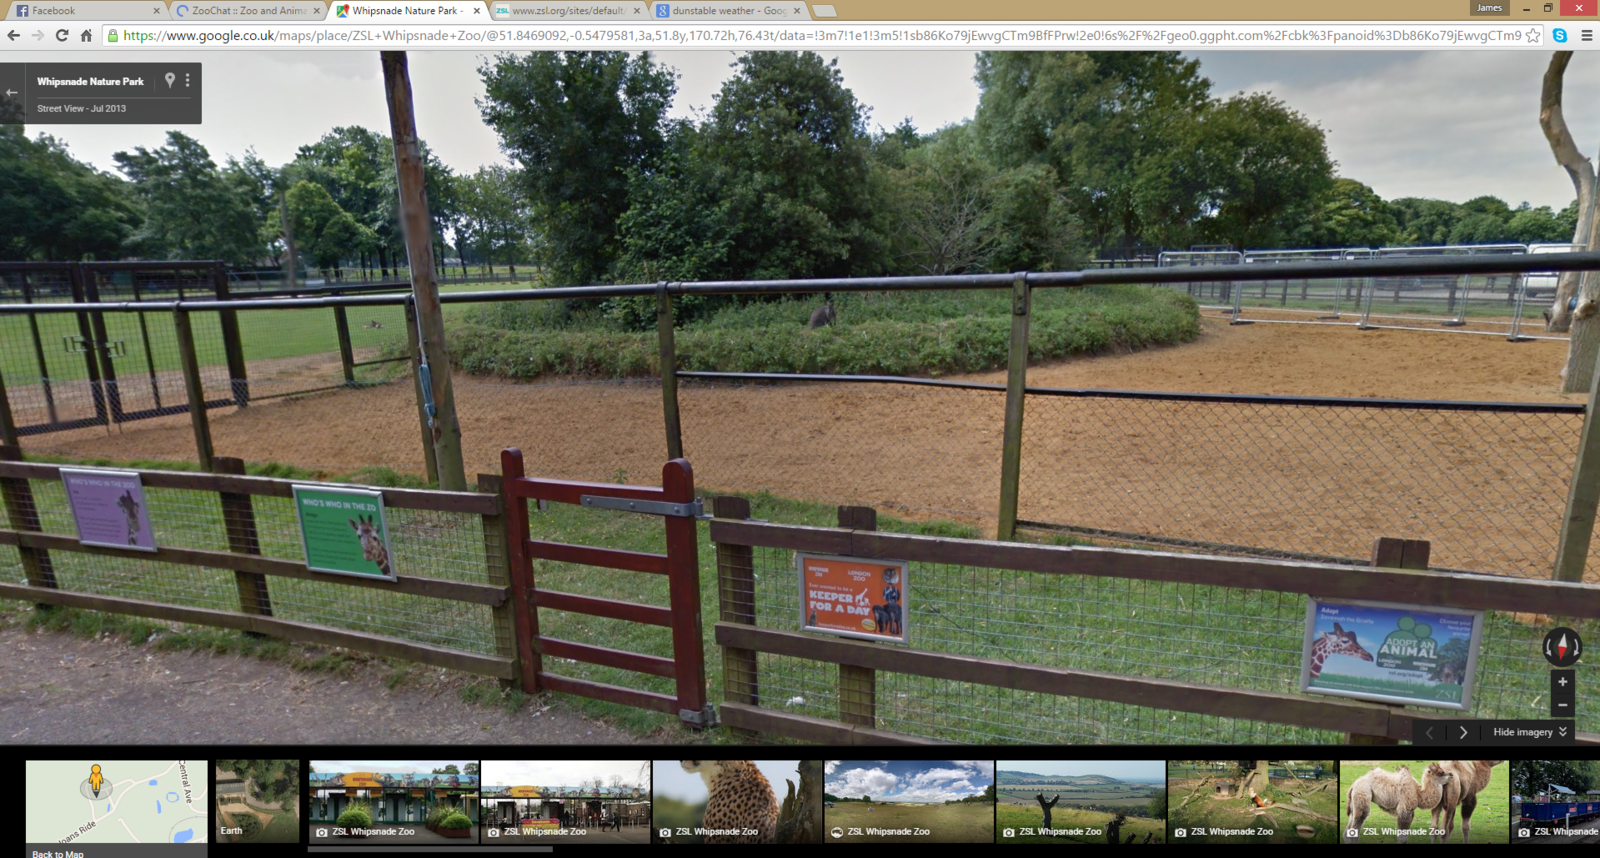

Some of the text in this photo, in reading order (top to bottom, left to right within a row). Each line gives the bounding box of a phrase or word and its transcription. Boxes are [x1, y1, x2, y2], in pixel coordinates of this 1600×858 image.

[33, 5, 75, 15] Facebook
[193, 6, 231, 15] ZooChat
[240, 6, 258, 15] Zoo
[261, 6, 277, 15] and
[353, 6, 402, 18] Whipsnade
[405, 6, 435, 15] Nature
[439, 6, 457, 15] Park
[673, 6, 716, 15] dunstable
[719, 6, 755, 15] weather
[764, 6, 787, 18] Goog
[1477, 3, 1503, 12] James
[37, 77, 144, 88] Whipsnade Nature Park
[37, 104, 62, 113] Street
[64, 104, 84, 113] View
[91, 104, 104, 113] Jul
[106, 104, 126, 113] 2013
[302, 498, 324, 506] WHO'S
[325, 500, 341, 508] WHO
[352, 502, 365, 510] THE
[810, 590, 853, 603] KEEPER
[810, 601, 870, 616] FOR A DAY
[1386, 638, 1418, 647] ADOPT
[1380, 644, 1438, 659] ANIMAL
[1435, 690, 1459, 701] ZSL
[1494, 728, 1553, 740] Hide imagery
[179, 760, 192, 803] Central Ave
[78, 821, 96, 834] Ride
[220, 826, 242, 836] Earth
[1535, 828, 1599, 837] ZSL Whipsnade
[332, 828, 414, 838] ZSL Whipsnade Zoo
[504, 828, 586, 838] ZSL Whipsnade Zoo
[676, 828, 758, 838] ZSL Whipsnade Zoo
[848, 828, 930, 838] ZSL Whipsnade Zoo
[1020, 828, 1102, 838] ZSL Whipsnade Zoo
[1191, 828, 1273, 838] ZSL Whipsnade Zoo
[1363, 828, 1445, 838] ZSL Whipsnade Zoo
